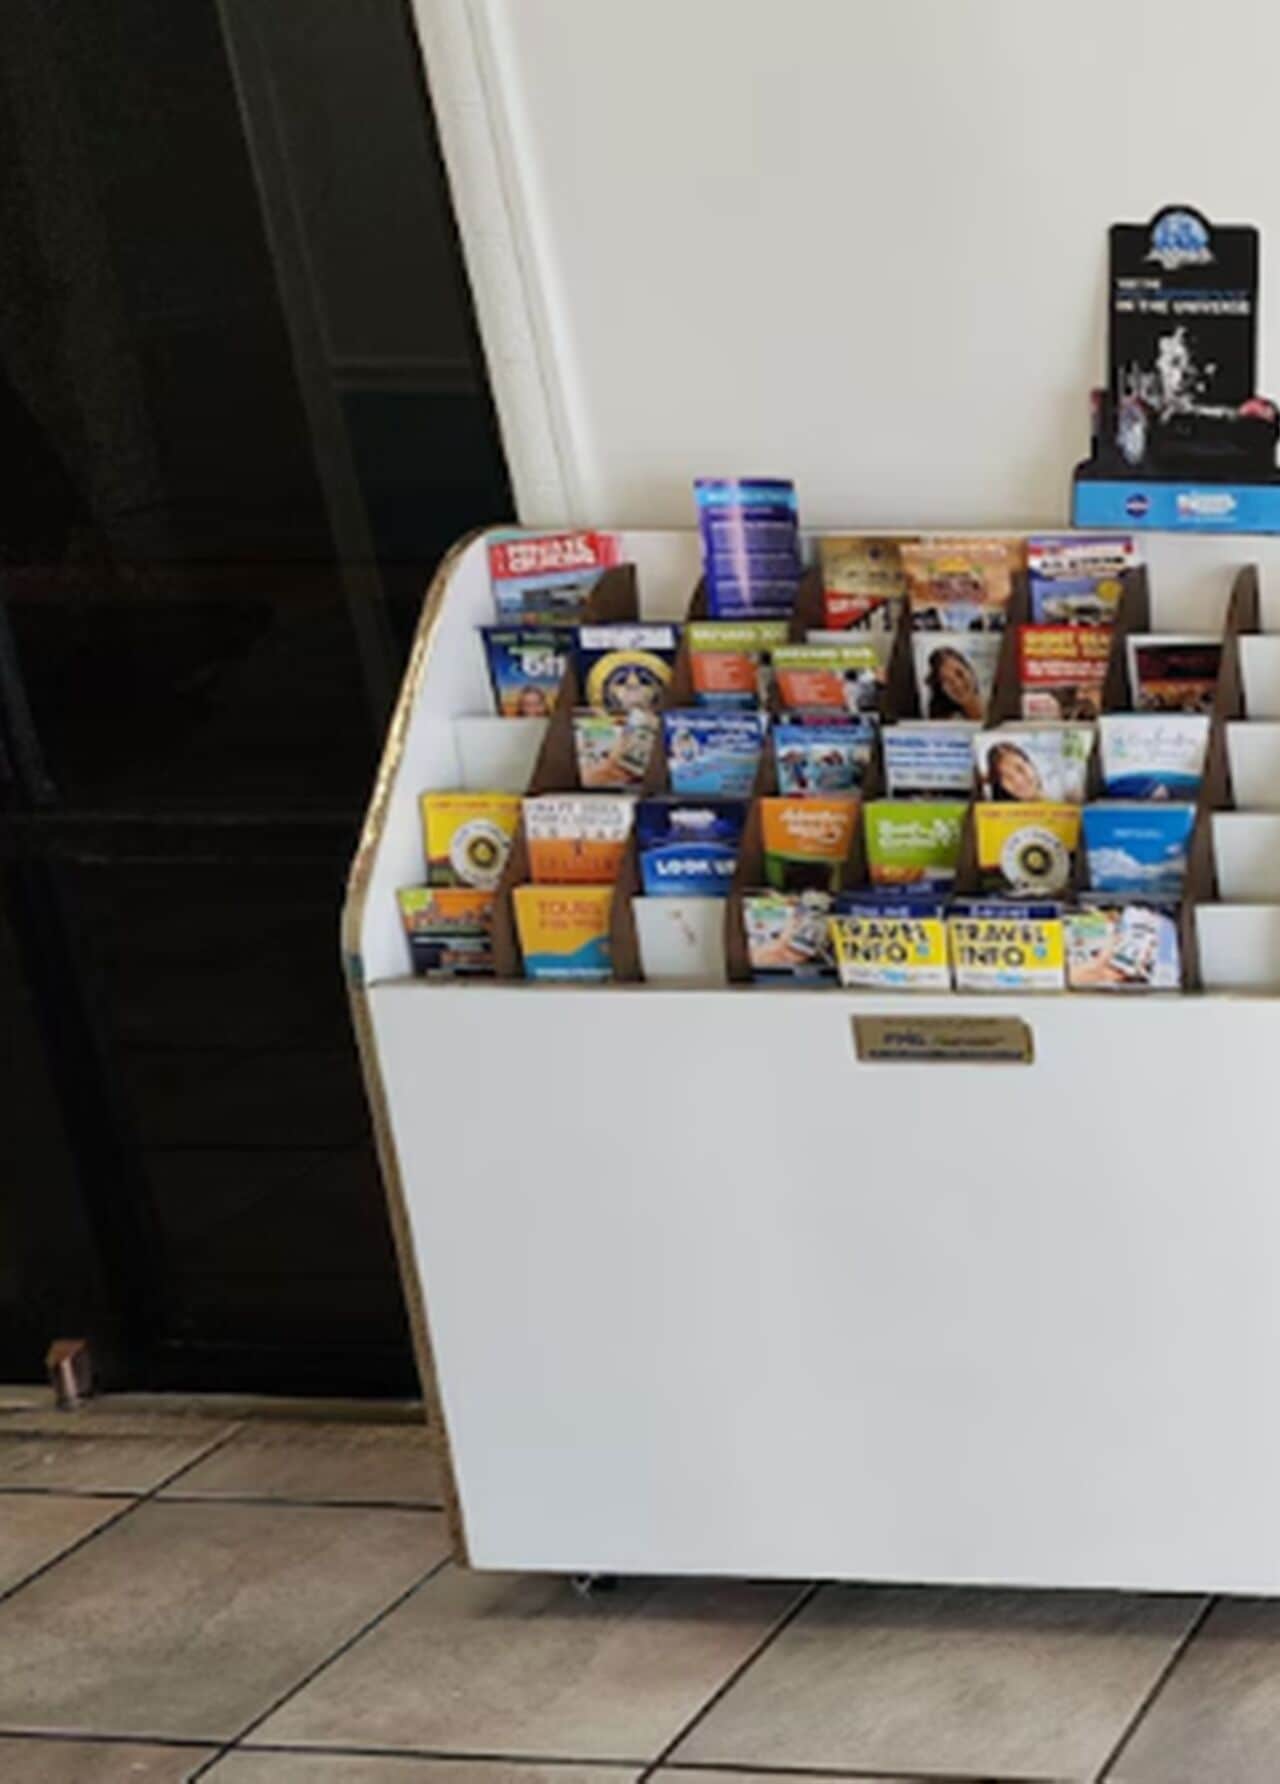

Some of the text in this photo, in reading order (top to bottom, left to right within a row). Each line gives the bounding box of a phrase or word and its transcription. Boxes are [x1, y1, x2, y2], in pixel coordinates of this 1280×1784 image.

[655, 859, 713, 876] LOOK
[835, 917, 929, 944] TRAVEL
[953, 921, 1047, 945] TRAVEL
[841, 939, 909, 963] INFO
[958, 943, 1027, 967] INFO
